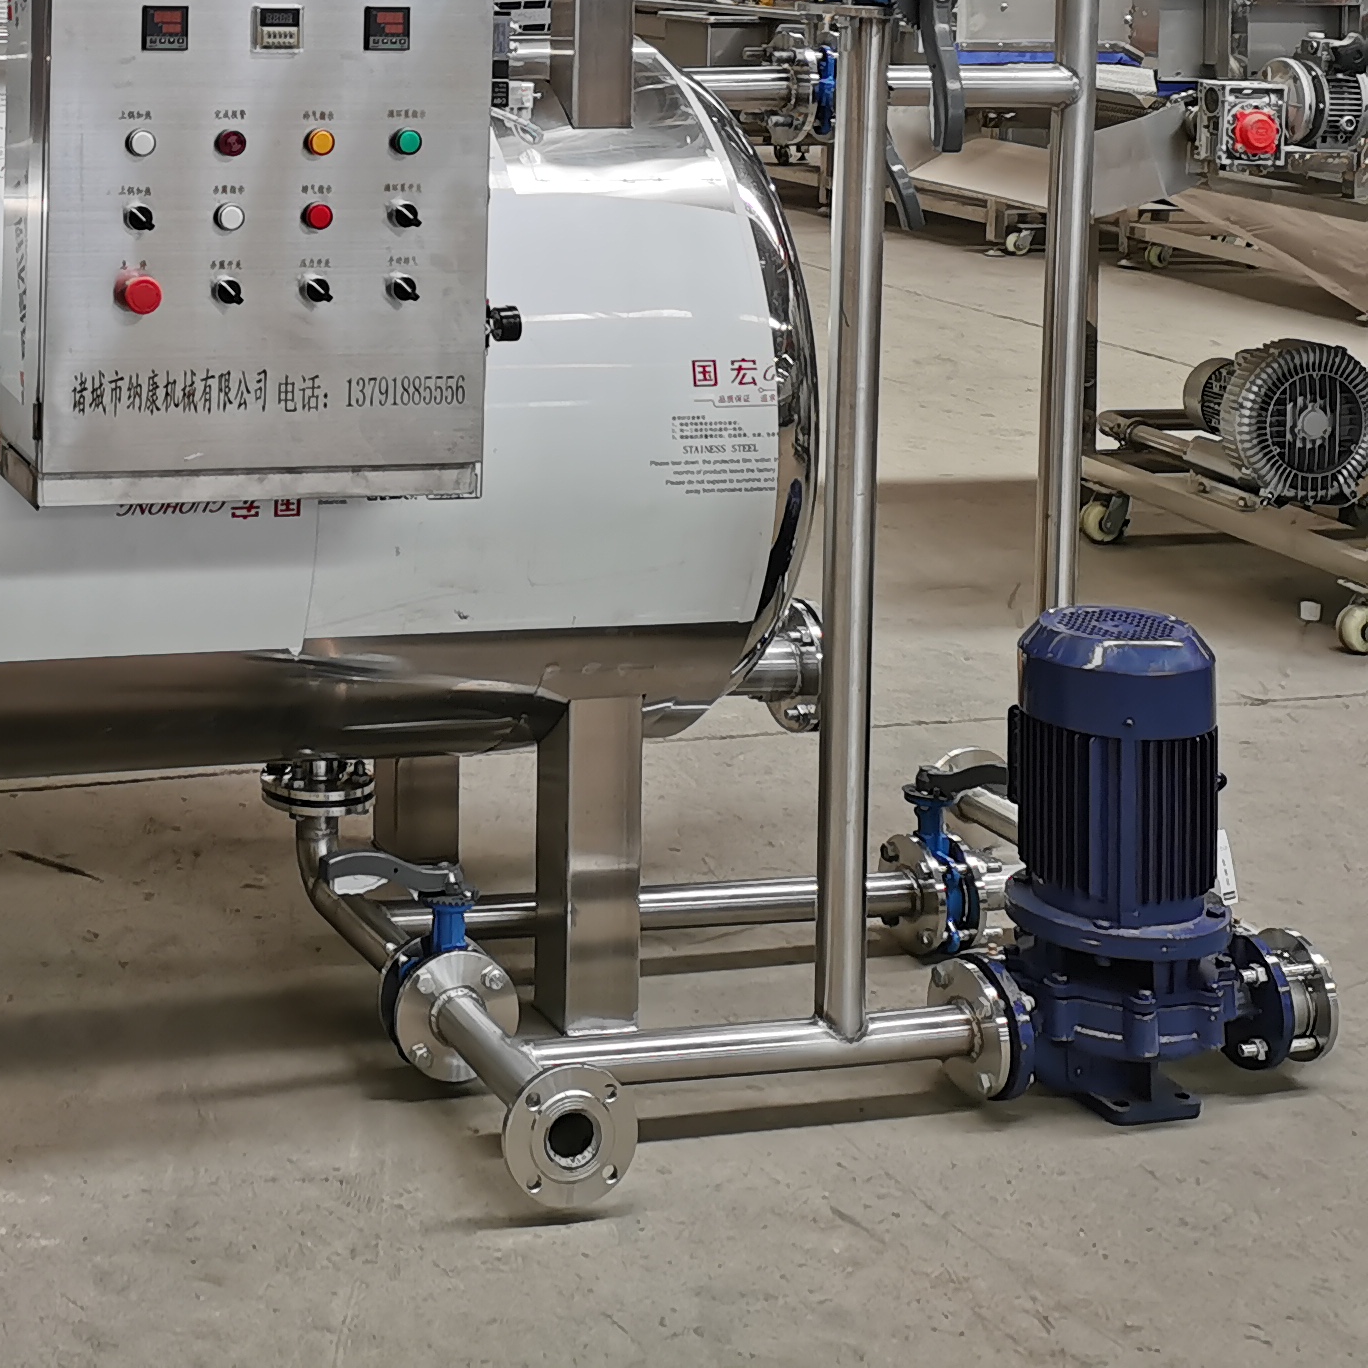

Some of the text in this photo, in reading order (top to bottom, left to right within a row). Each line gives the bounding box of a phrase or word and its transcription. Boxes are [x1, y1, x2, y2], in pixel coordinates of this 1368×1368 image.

[118, 110, 152, 121] 上锅加热
[118, 185, 152, 196] 上锅加热
[692, 358, 758, 387] 国宏
[70, 368, 269, 418] 诸城市纳康机械有限公司
[344, 375, 466, 409] 13791885556
[683, 443, 759, 454] STAINESS STEEL
